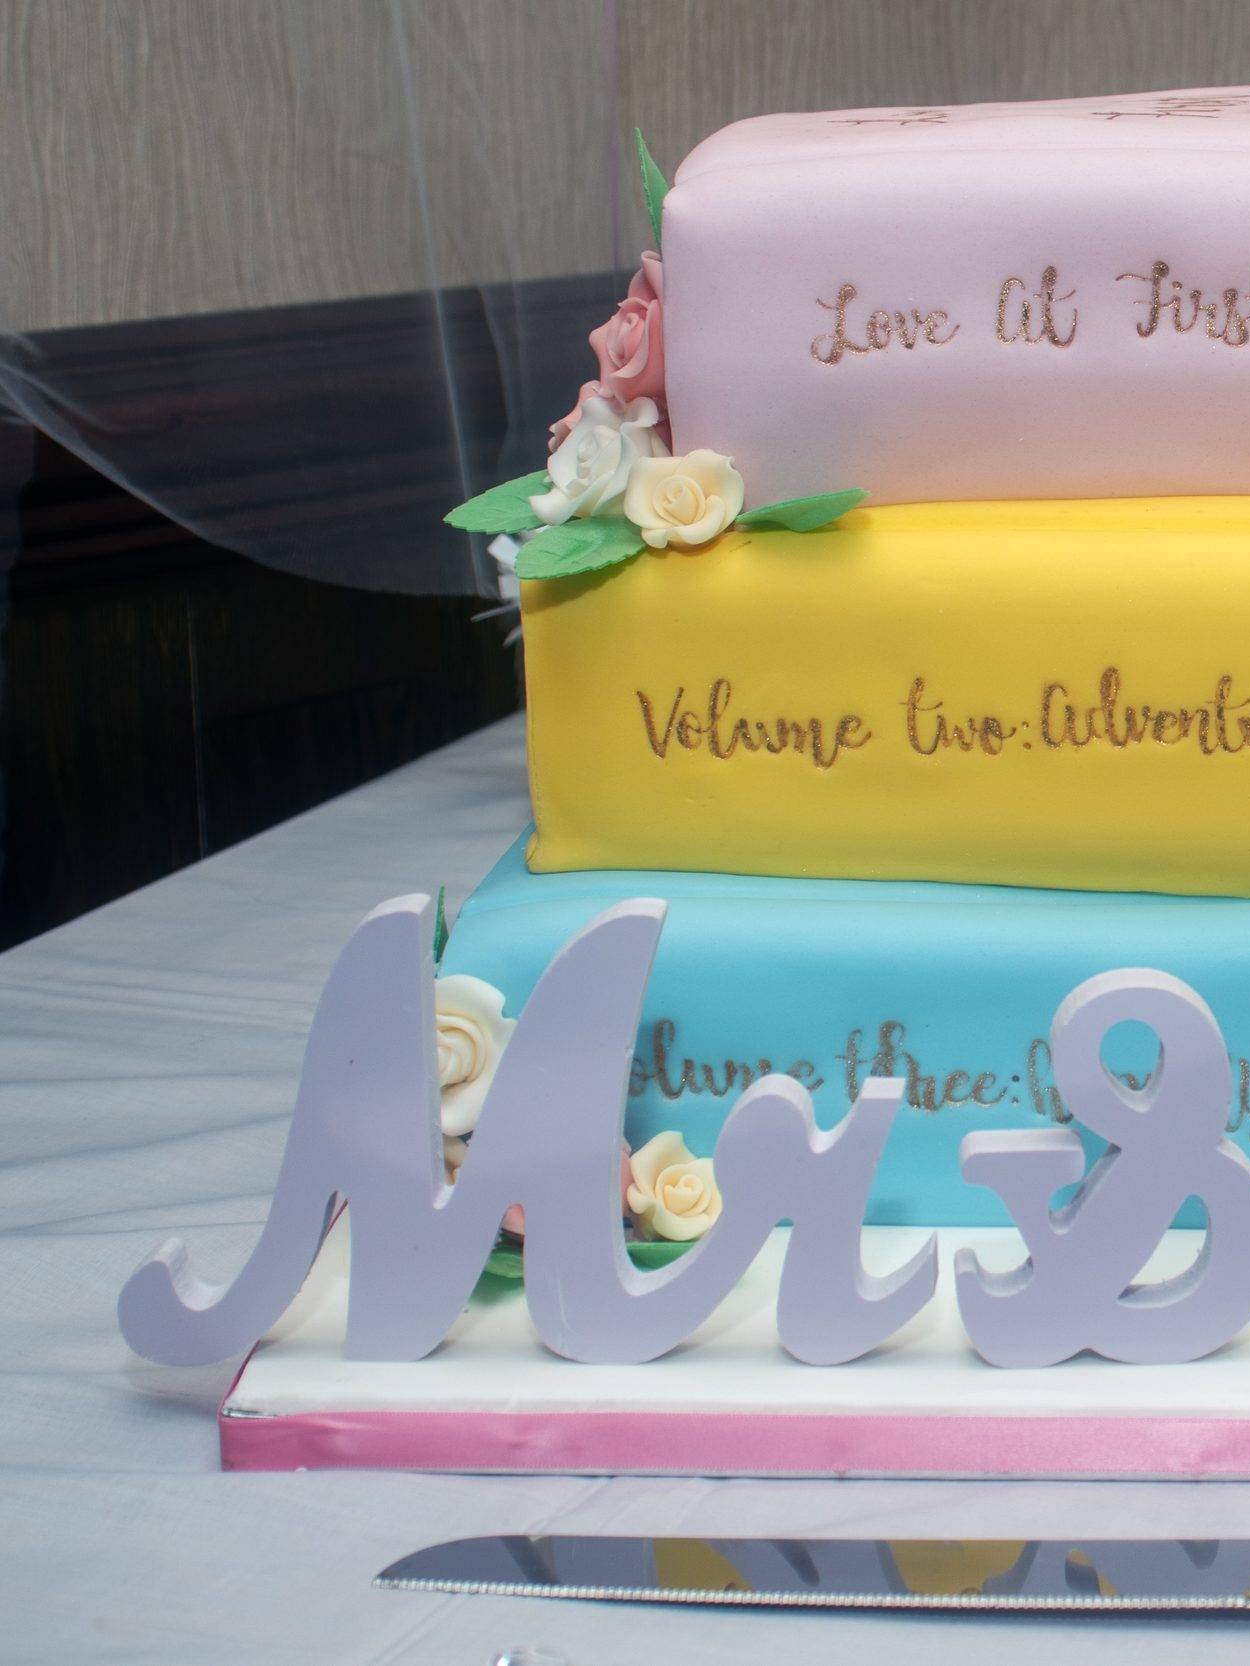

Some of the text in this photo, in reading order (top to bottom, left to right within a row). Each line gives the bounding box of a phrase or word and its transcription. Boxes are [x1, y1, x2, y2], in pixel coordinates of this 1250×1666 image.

[810, 281, 960, 366] Love
[635, 678, 873, 770] Volume
[632, 1018, 825, 1101] olume
[117, 893, 939, 1367] Mr
